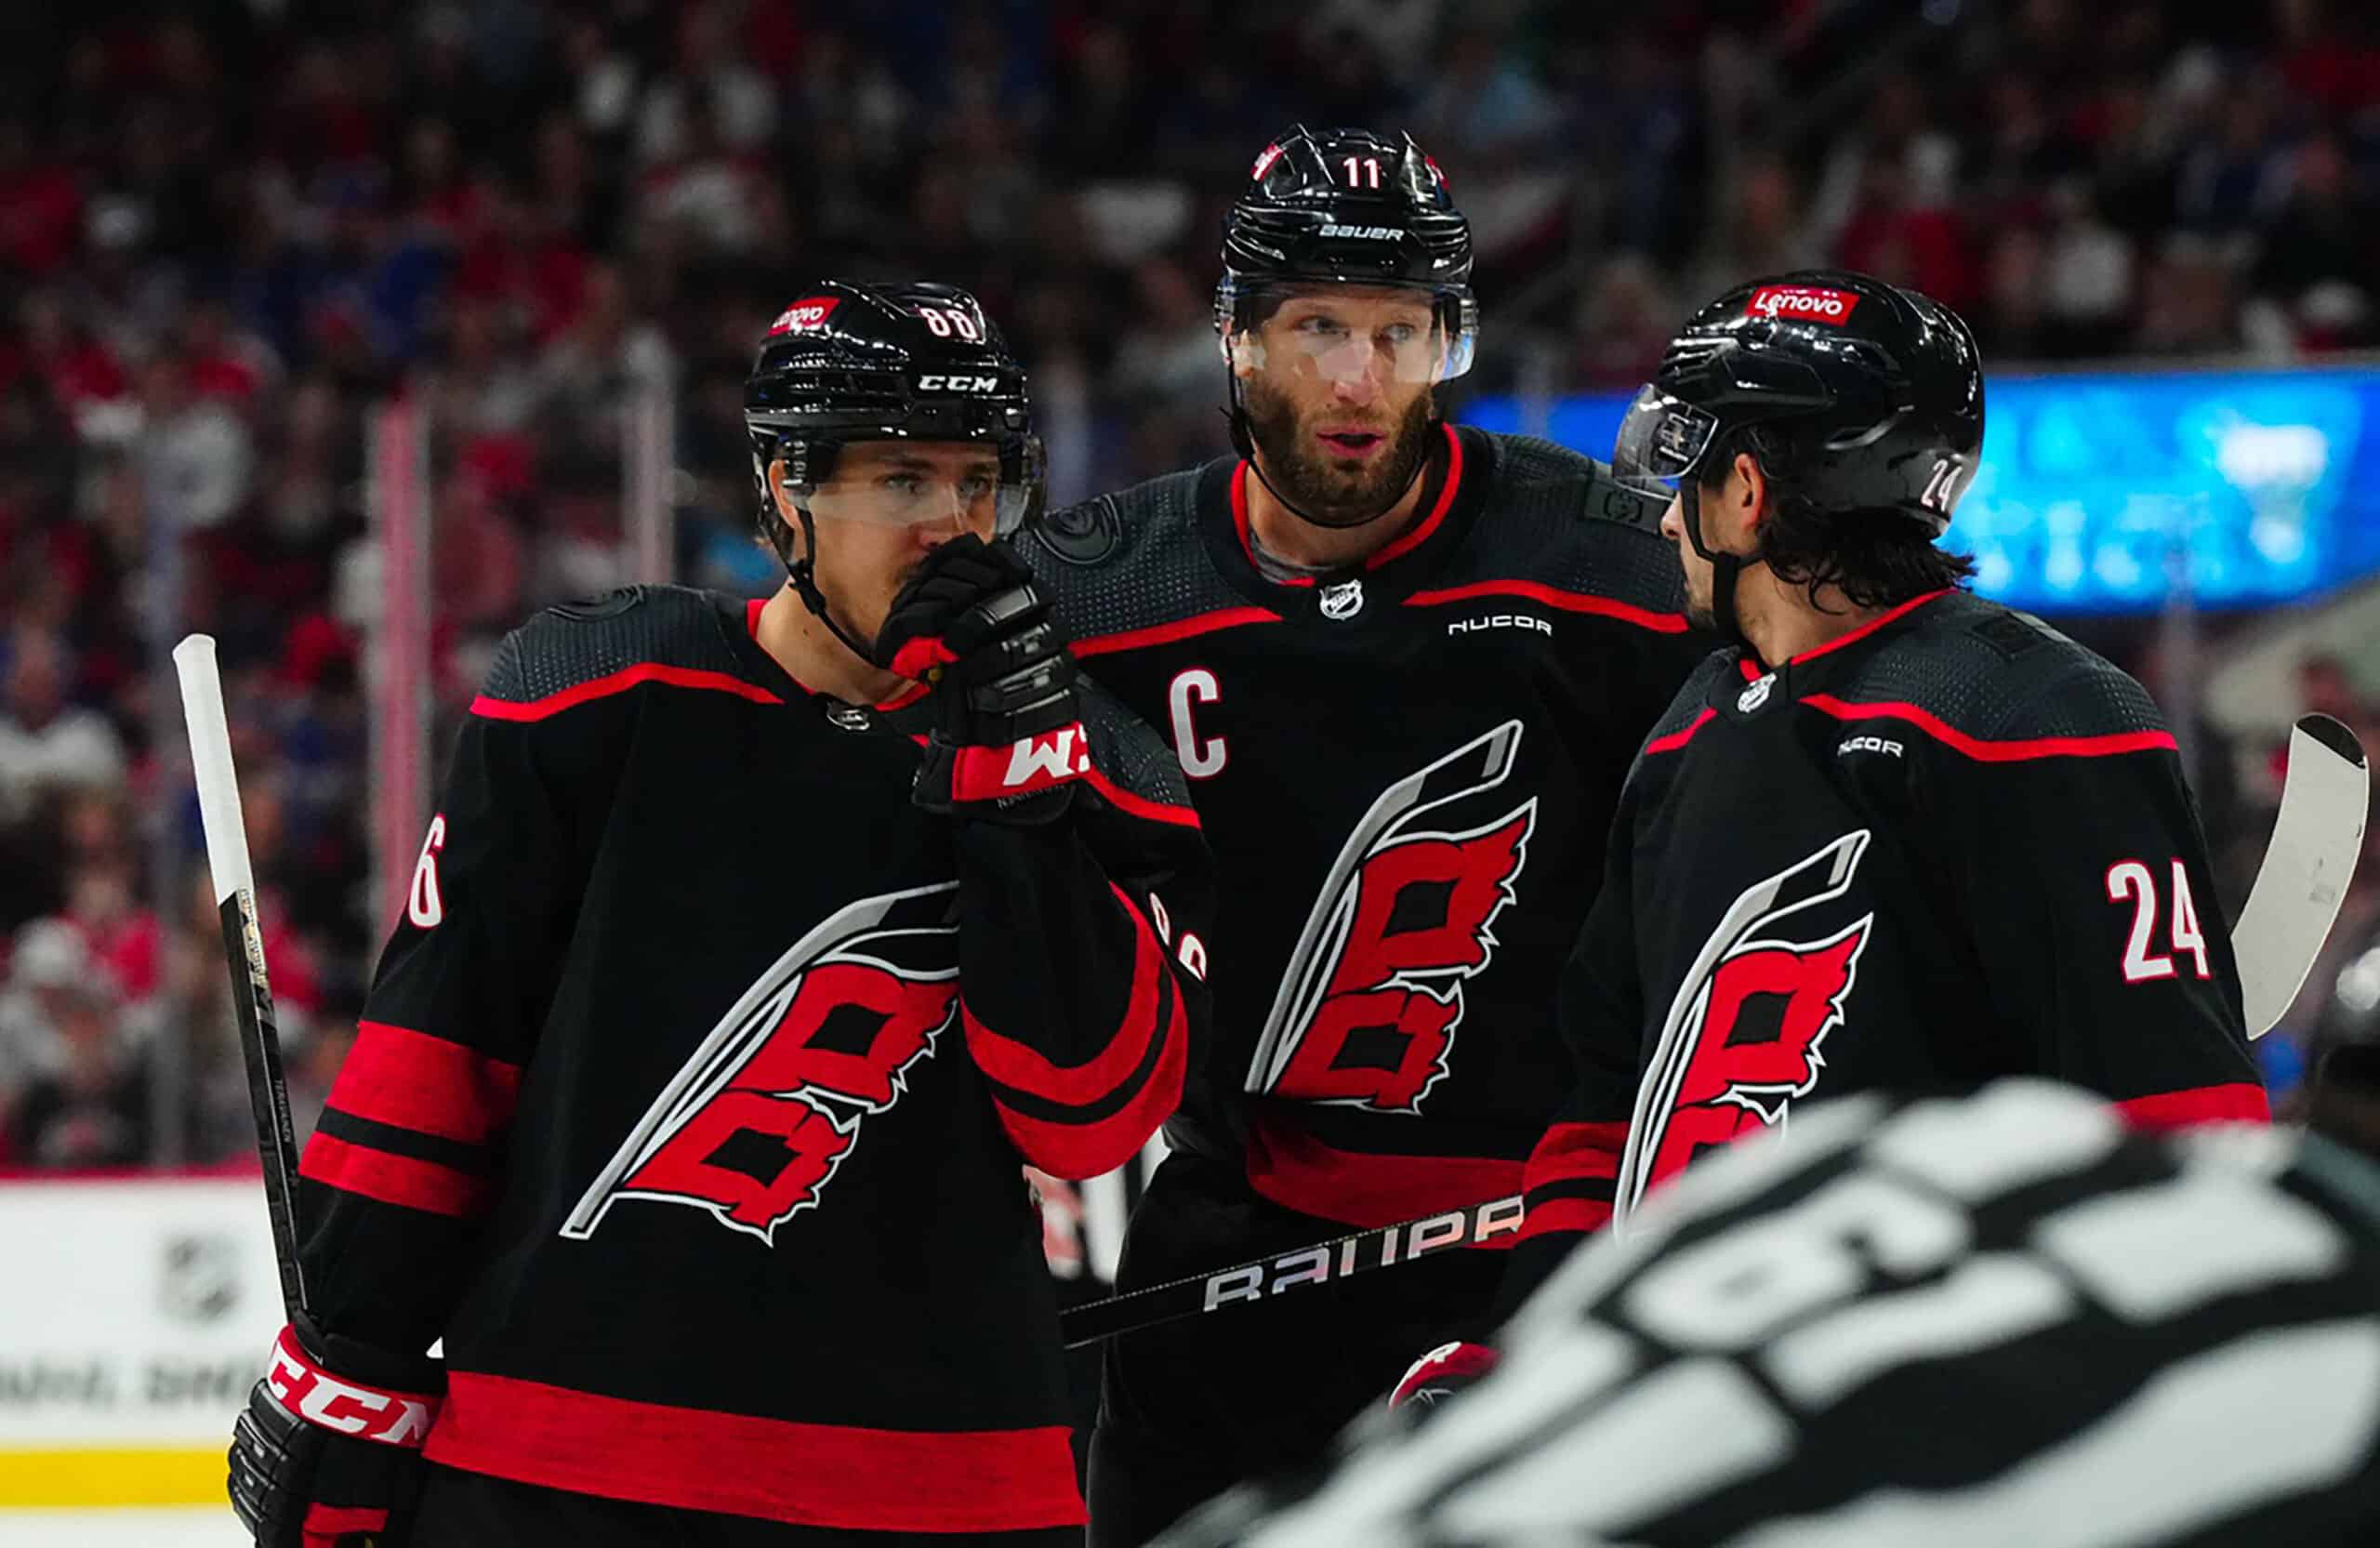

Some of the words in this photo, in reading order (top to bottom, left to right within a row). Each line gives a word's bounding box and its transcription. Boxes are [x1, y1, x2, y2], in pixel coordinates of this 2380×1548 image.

[1342, 155, 1382, 190] 11
[1319, 223, 1405, 243] BAUER
[1754, 292, 1844, 316] Lenovo
[918, 375, 998, 393] CCM
[1920, 457, 1964, 512] 24
[1448, 615, 1554, 637] NUCOR
[1168, 666, 1227, 779] C
[2103, 856, 2213, 986] 24
